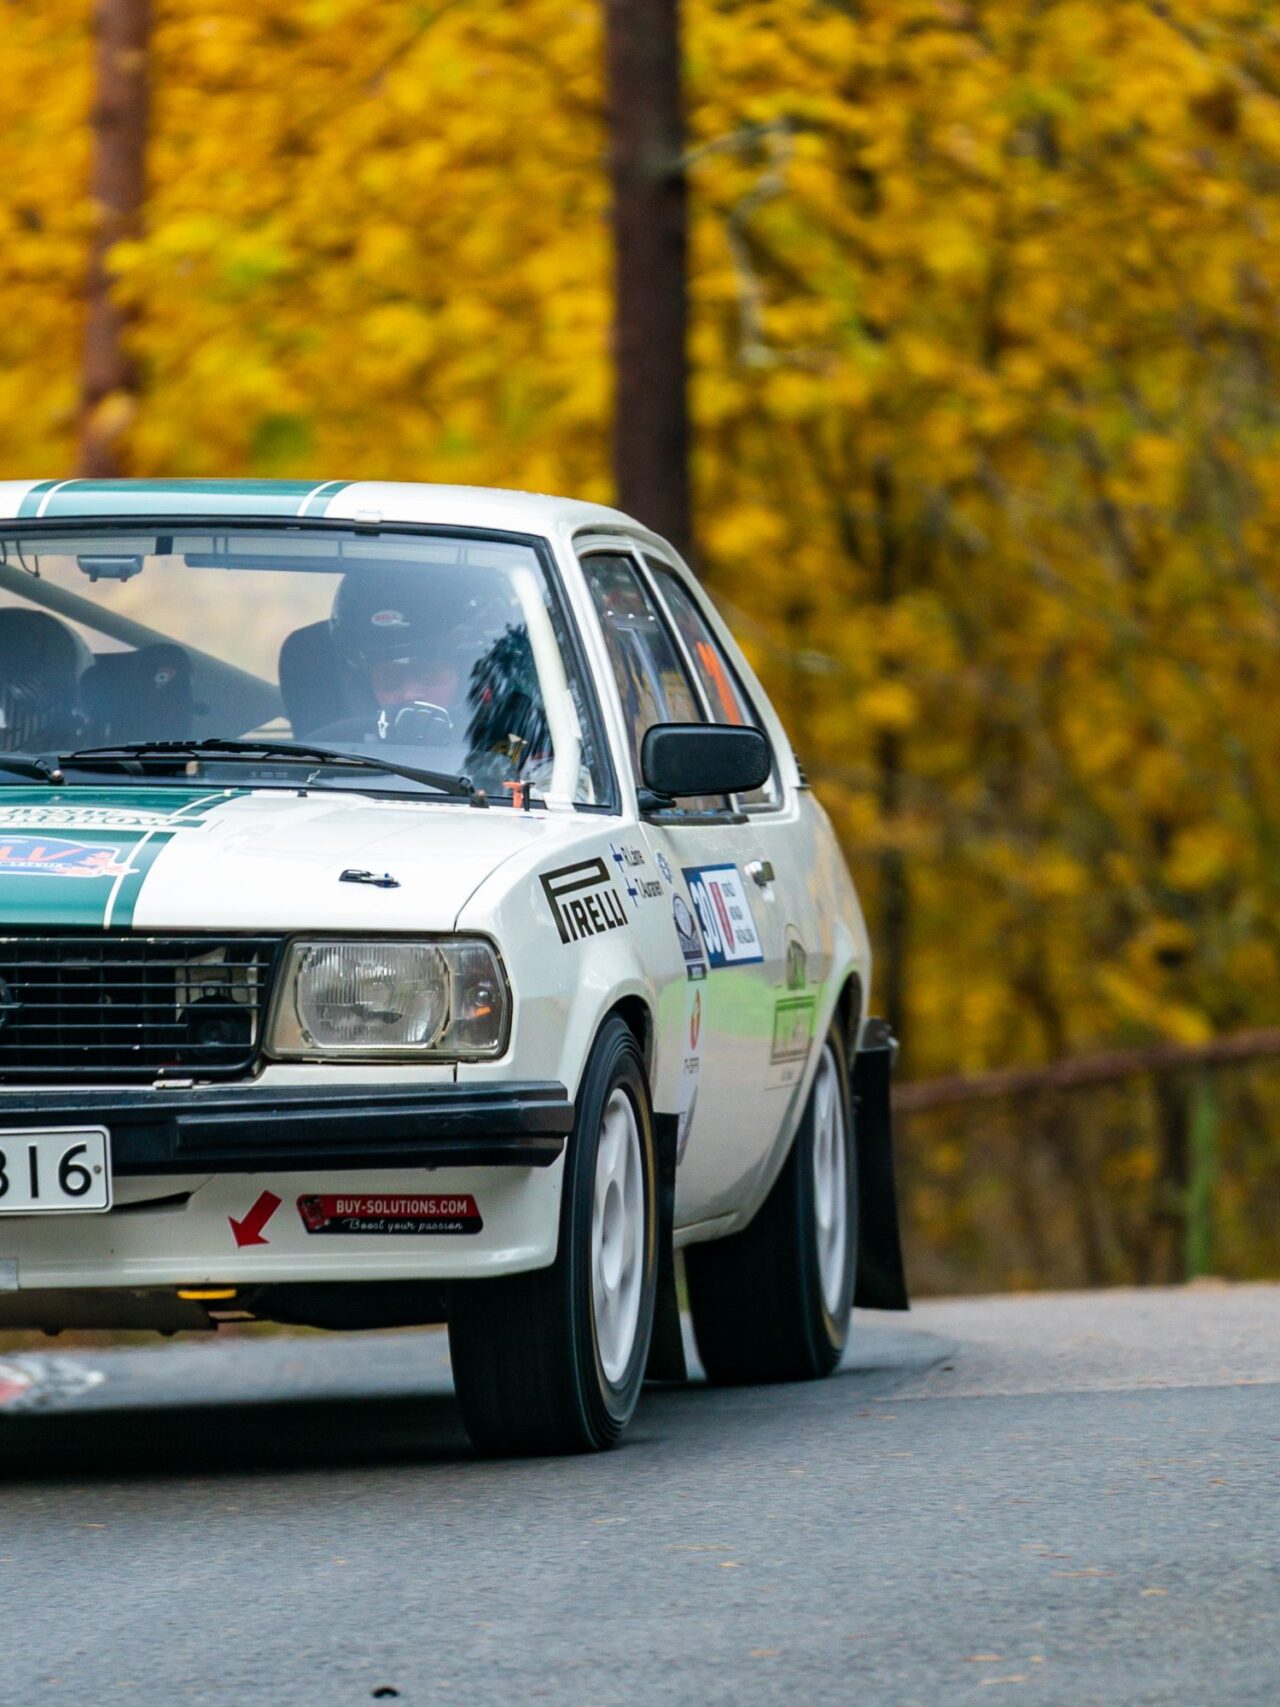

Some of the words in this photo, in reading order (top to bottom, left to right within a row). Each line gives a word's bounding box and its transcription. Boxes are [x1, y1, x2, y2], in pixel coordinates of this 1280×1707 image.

[538, 857, 629, 945] PIRELLI
[689, 881, 722, 955] 30
[336, 1200, 468, 1214] BUY-SOLUTIONS.COM
[343, 1218, 385, 1230] Boost
[387, 1221, 416, 1232] your
[417, 1222, 464, 1232] passion
